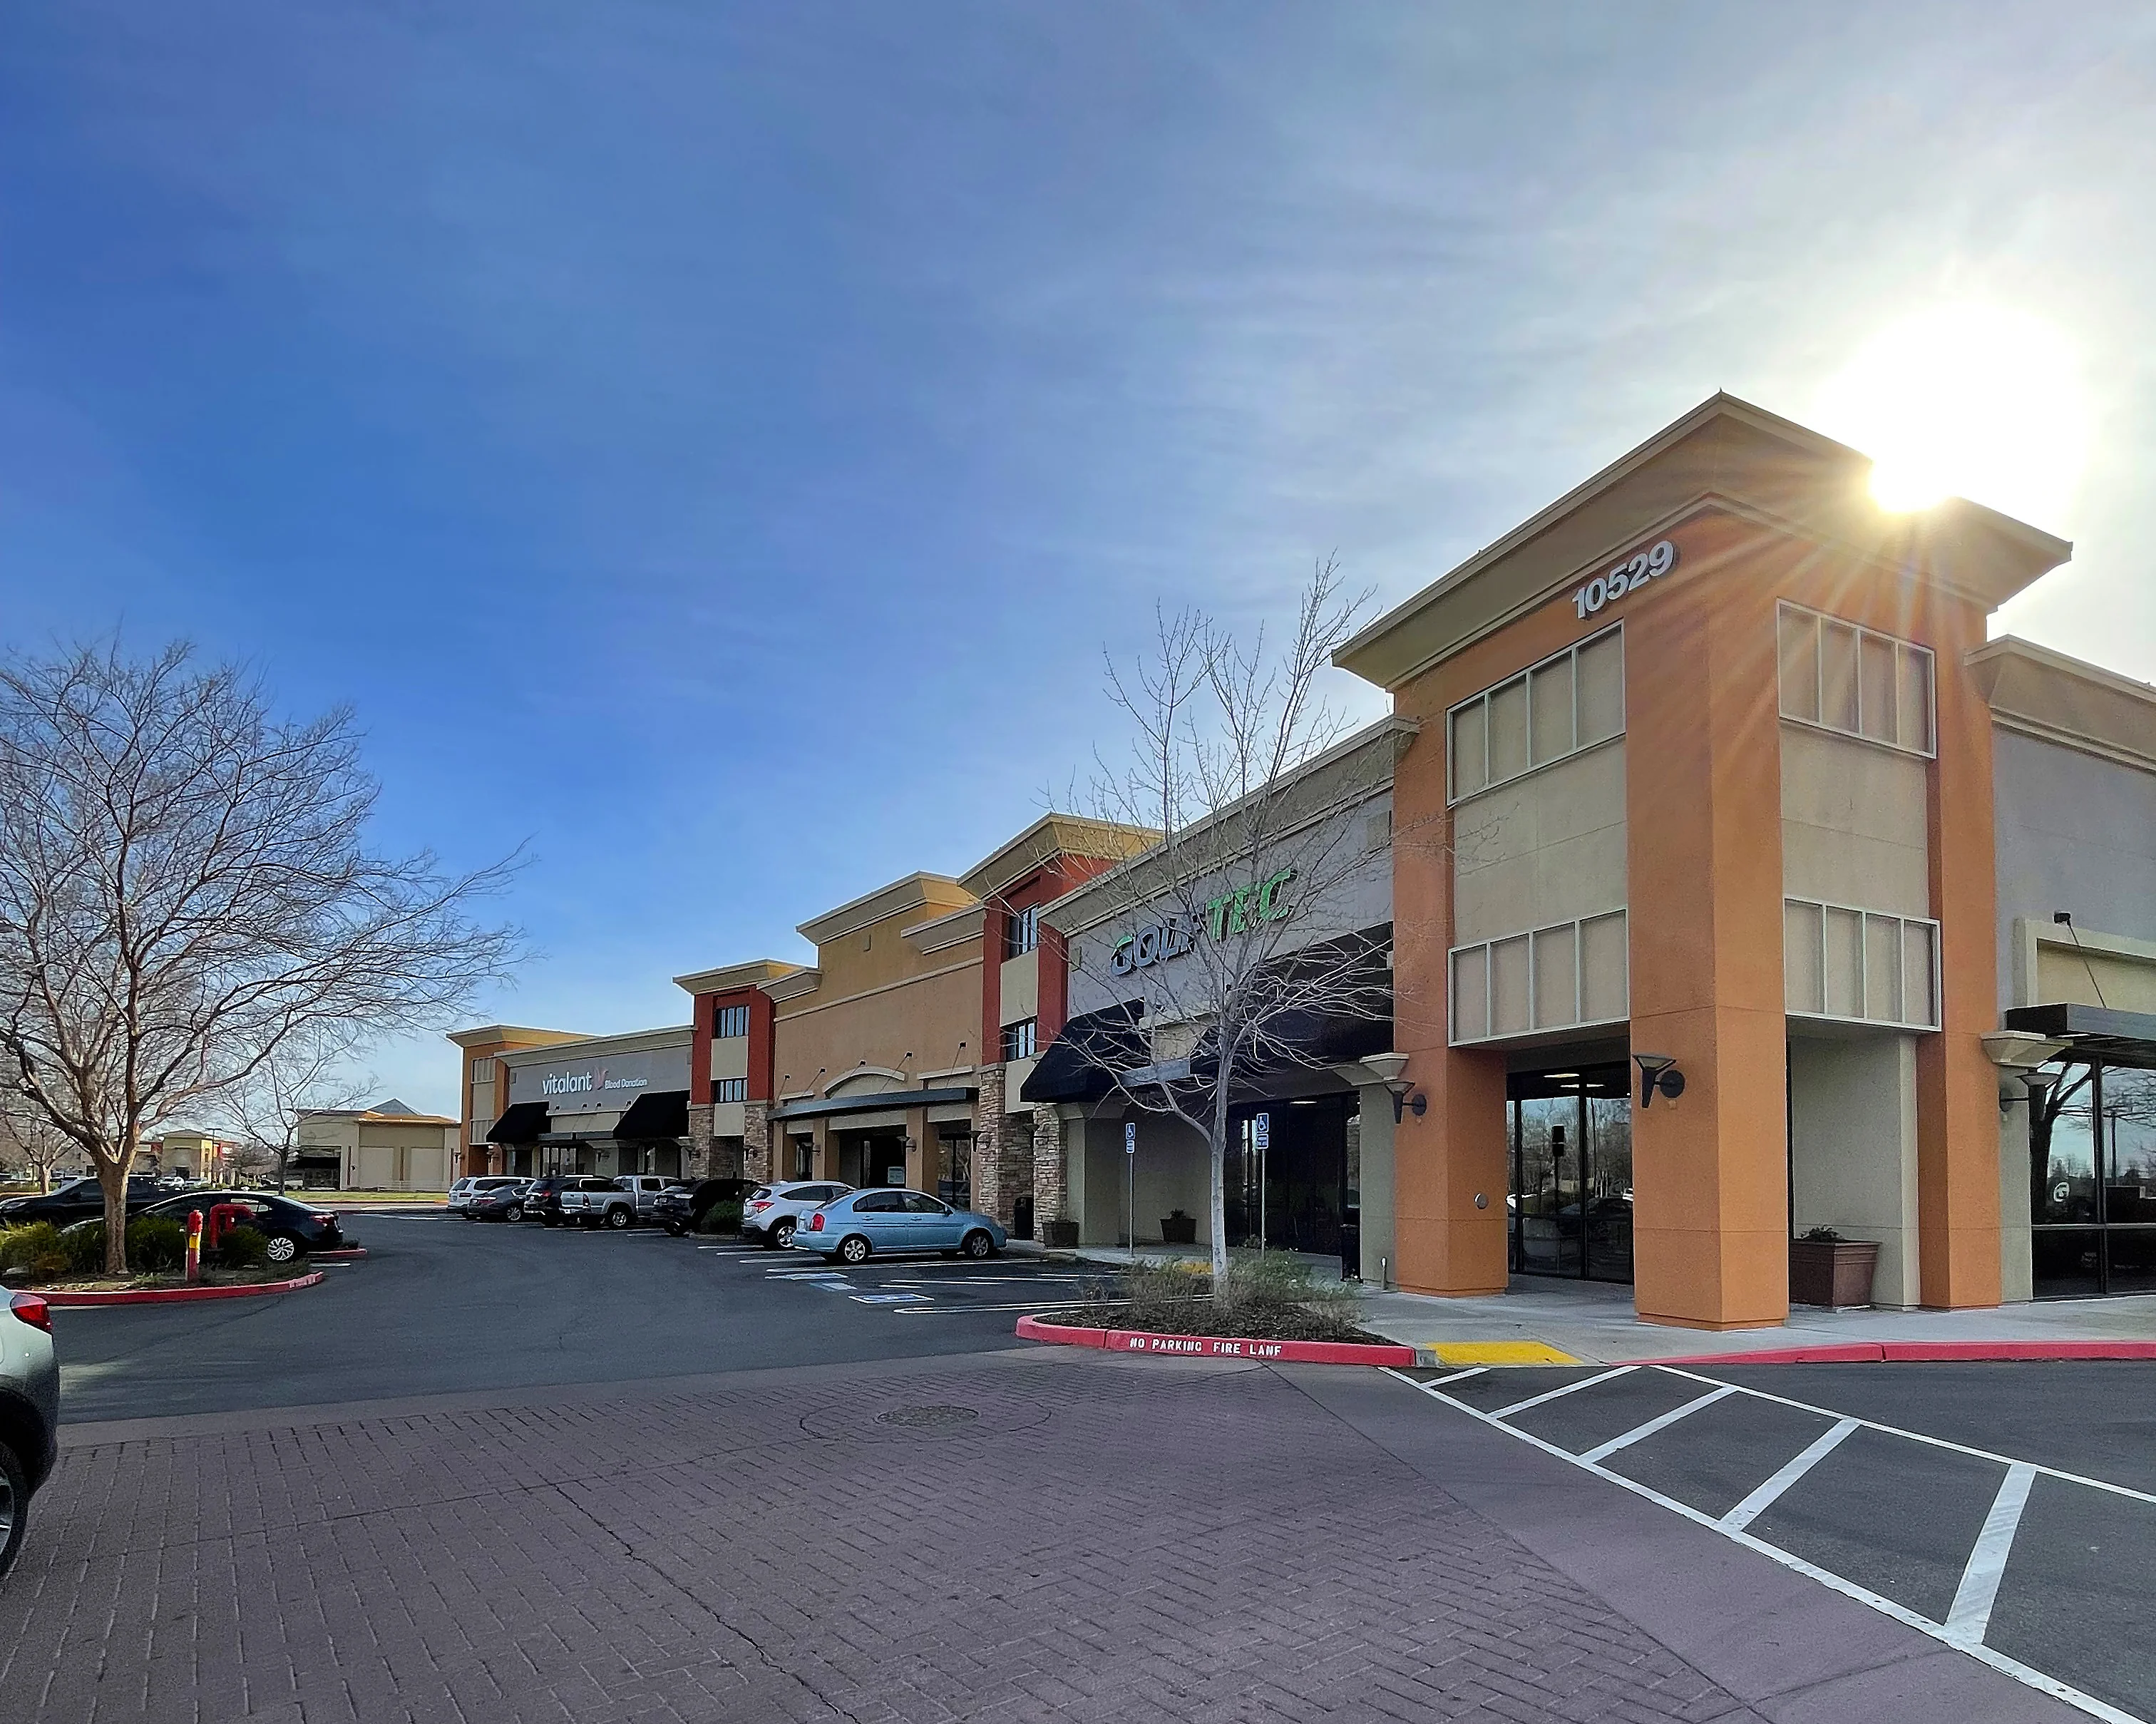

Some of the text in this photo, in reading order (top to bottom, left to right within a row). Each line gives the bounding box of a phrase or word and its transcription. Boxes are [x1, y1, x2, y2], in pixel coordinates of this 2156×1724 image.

[1571, 540, 1674, 620] 10529
[543, 1071, 592, 1094] vitalant
[605, 1078, 647, 1089] Blood Donation
[1129, 1338, 1145, 1348] NO
[1151, 1338, 1202, 1352] PARKING
[1213, 1341, 1241, 1354] FIRE
